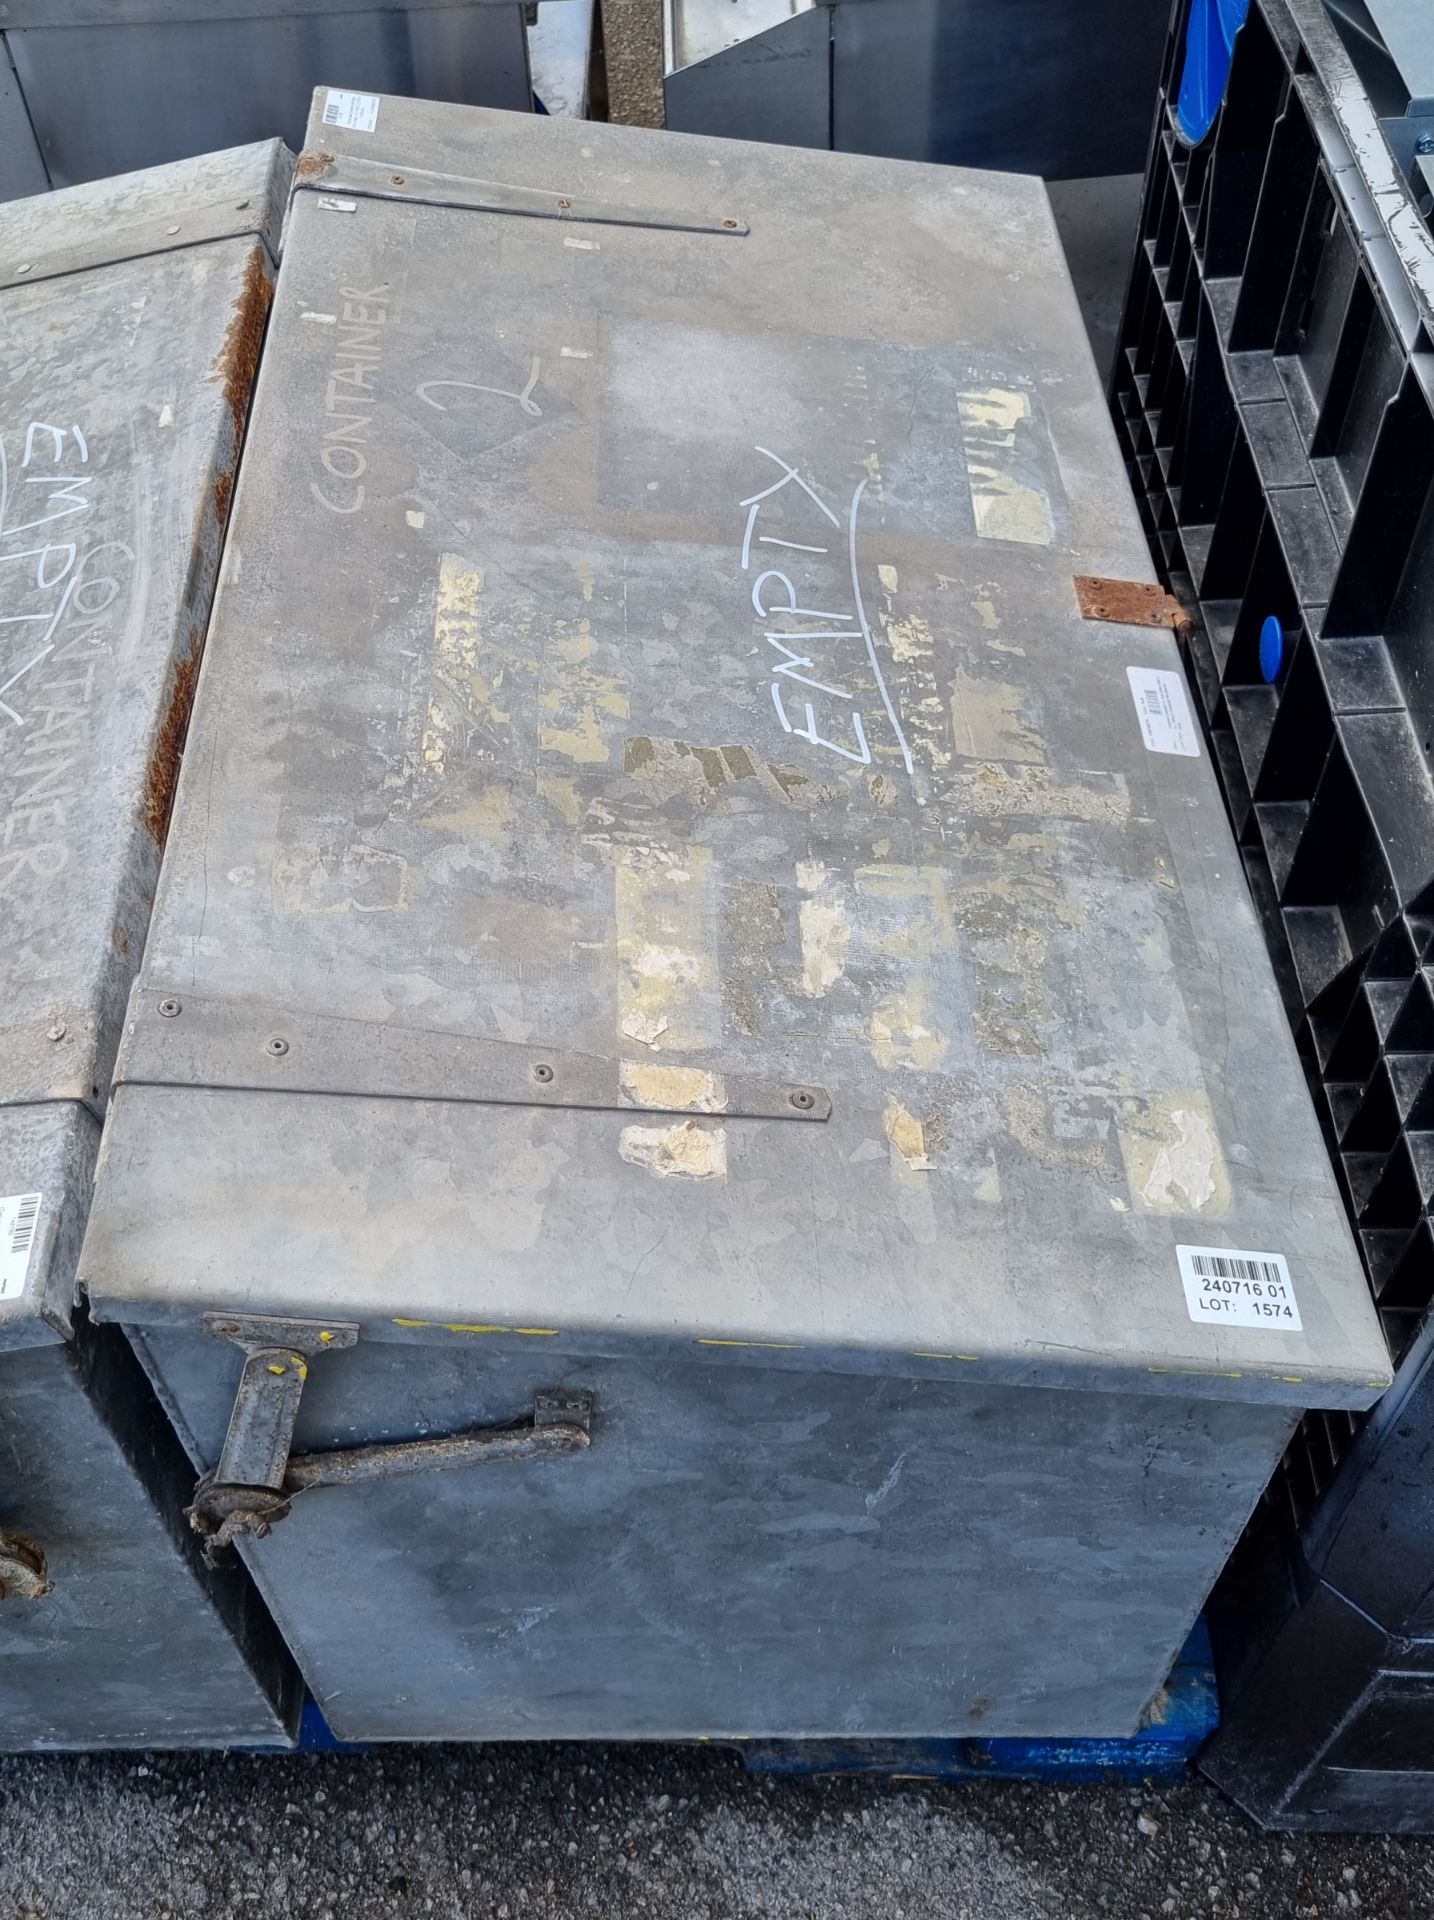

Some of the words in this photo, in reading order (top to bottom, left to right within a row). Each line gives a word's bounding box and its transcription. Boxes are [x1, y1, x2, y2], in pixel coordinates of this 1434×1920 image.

[310, 286, 390, 514] CONTAINER
[416, 356, 543, 416] 2
[739, 446, 872, 765] EMPTY
[1199, 1298, 1237, 1312] LOT:
[1252, 1302, 1293, 1318] 1574
[1202, 1278, 1262, 1296] 240716
[1268, 1284, 1287, 1299] 01
